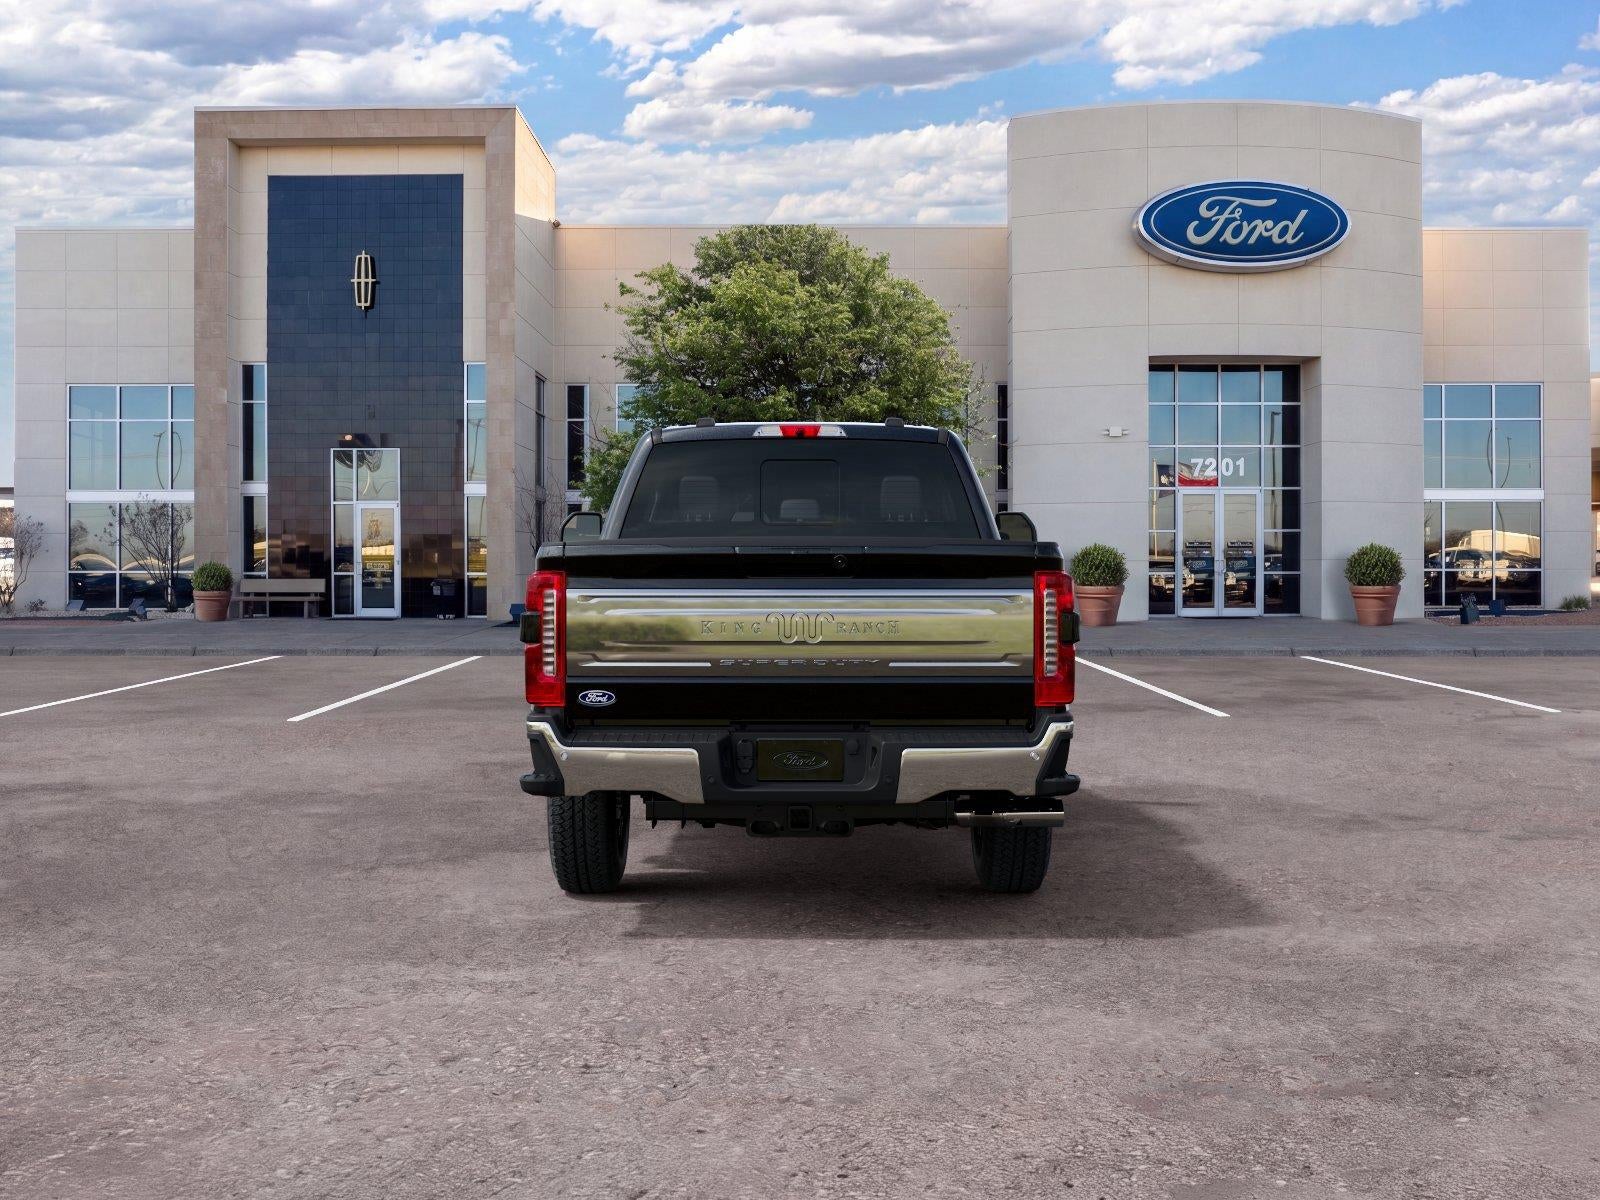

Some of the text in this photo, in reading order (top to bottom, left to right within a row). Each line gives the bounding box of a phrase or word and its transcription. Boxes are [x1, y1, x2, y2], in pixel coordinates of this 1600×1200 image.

[1186, 195, 1309, 246] Ford
[1190, 457, 1245, 477] 7201
[700, 620, 901, 635] KING RANCH
[719, 658, 880, 668] SUPER DUTY
[585, 692, 609, 702] Ford
[783, 751, 816, 767] Ford
